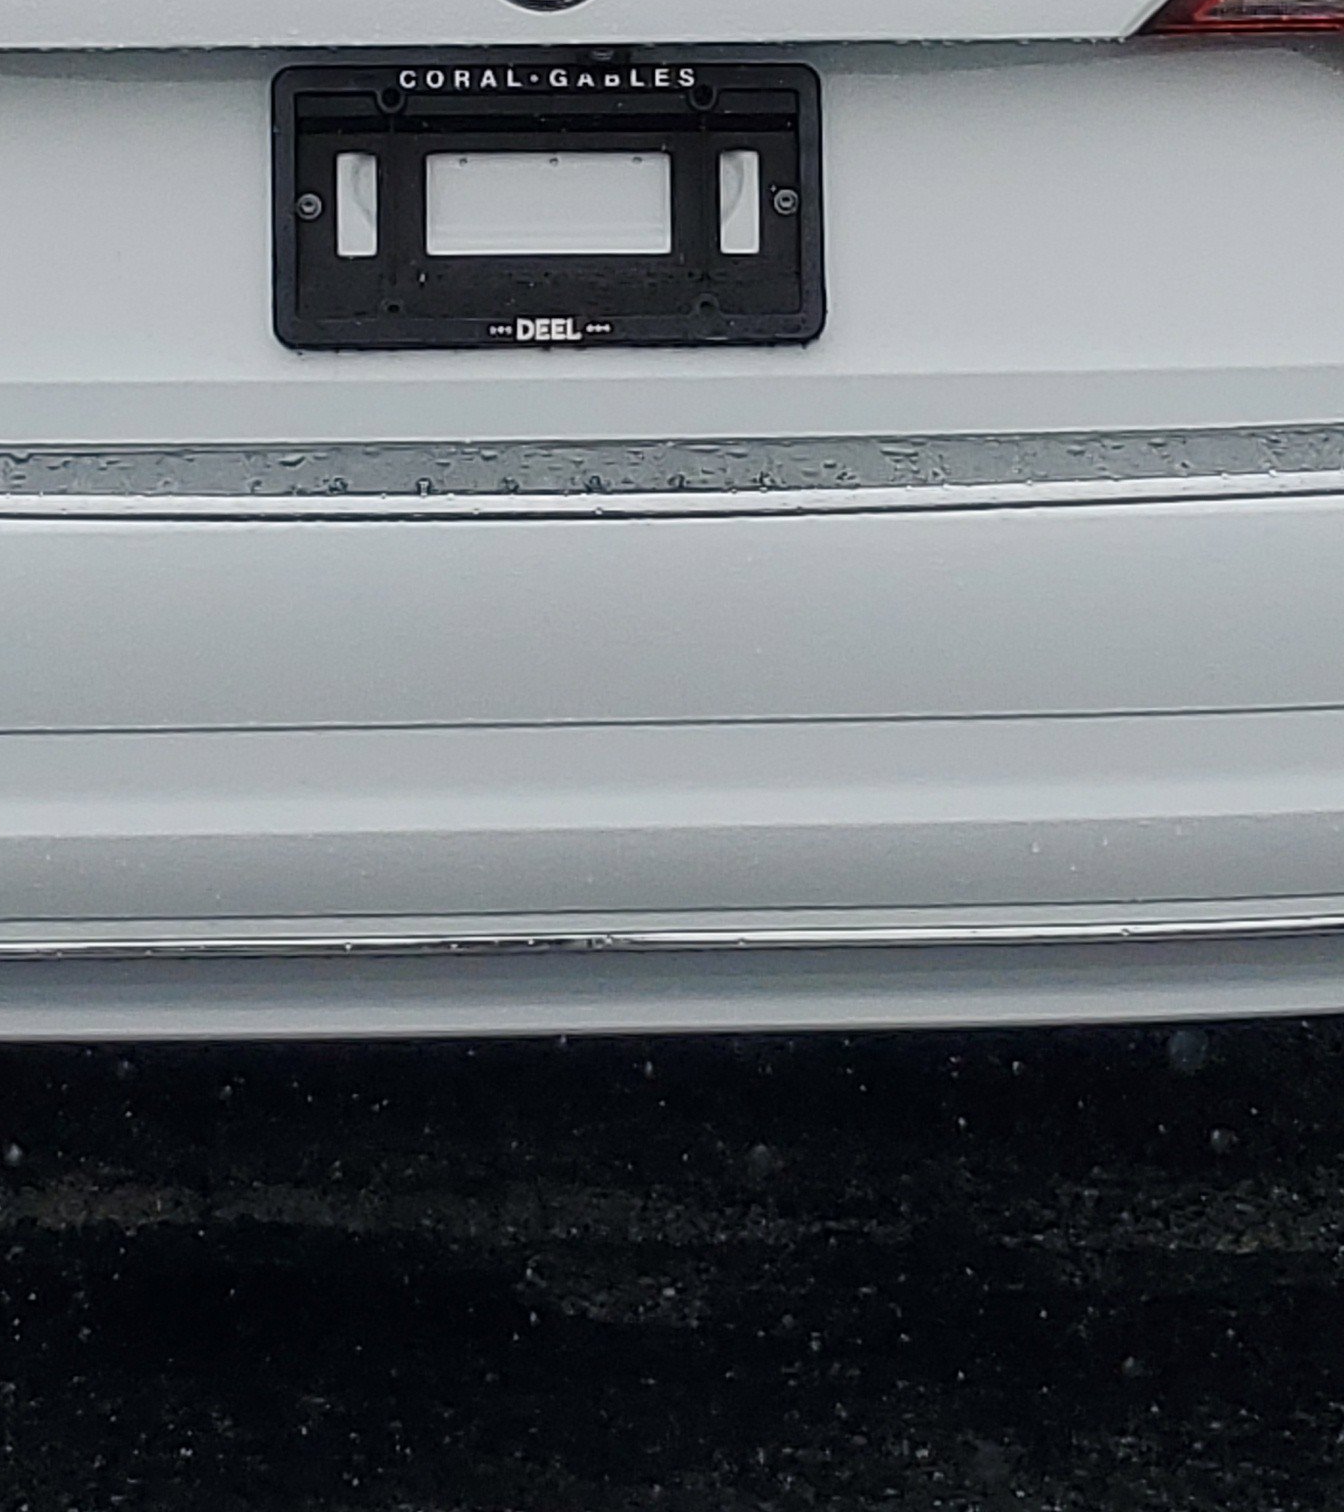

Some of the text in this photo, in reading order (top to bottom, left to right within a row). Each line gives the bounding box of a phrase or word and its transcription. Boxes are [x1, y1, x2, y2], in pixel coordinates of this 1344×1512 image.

[398, 68, 696, 89] CORAL GABLES
[516, 317, 583, 341] DEEL
